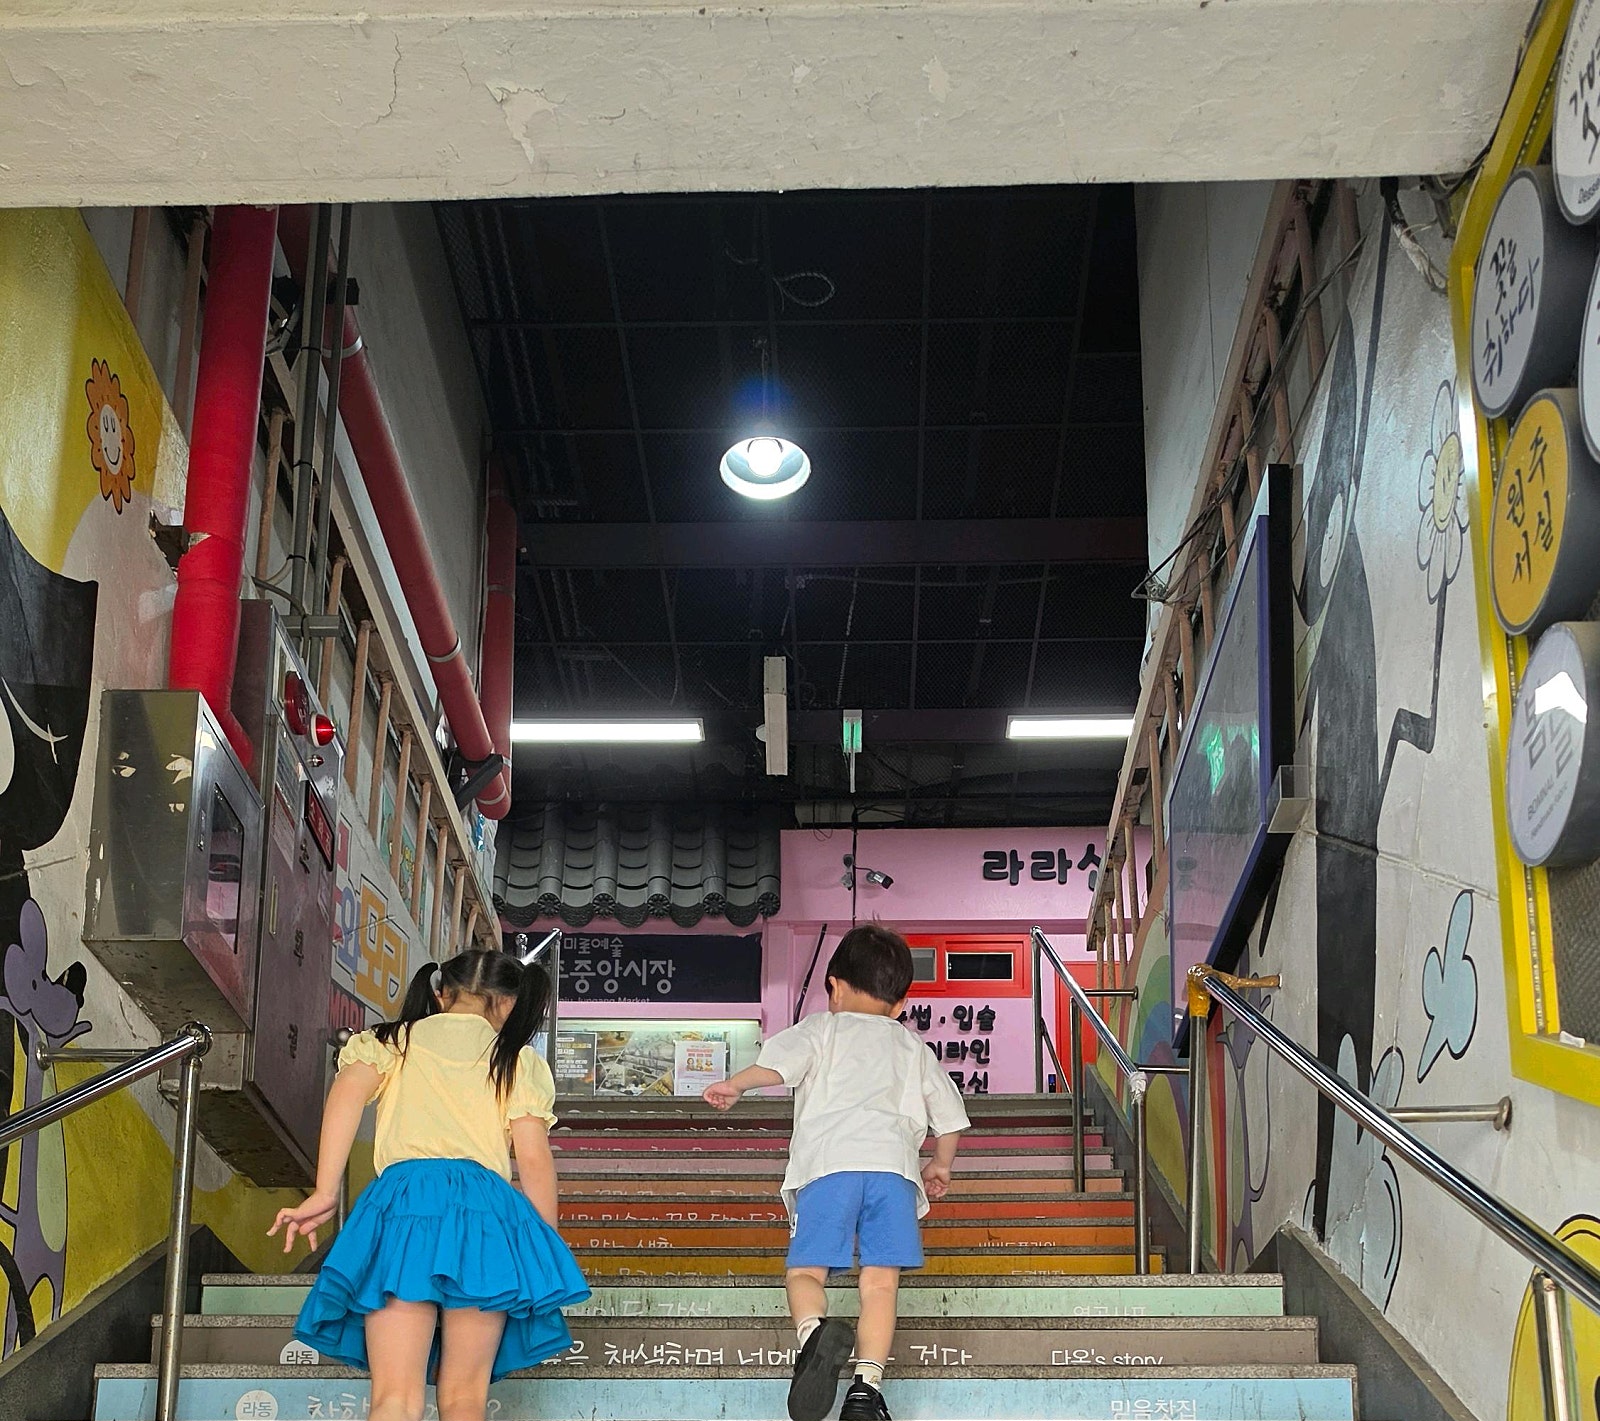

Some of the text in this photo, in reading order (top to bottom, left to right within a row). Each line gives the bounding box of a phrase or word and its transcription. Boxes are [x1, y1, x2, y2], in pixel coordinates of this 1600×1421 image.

[1506, 425, 1548, 529] 원주
[1511, 490, 1555, 584] 서실
[563, 936, 624, 958] 미로예술
[952, 1004, 996, 1032] 입술
[1113, 1352, 1164, 1365] story
[240, 1400, 273, 1420] 라동
